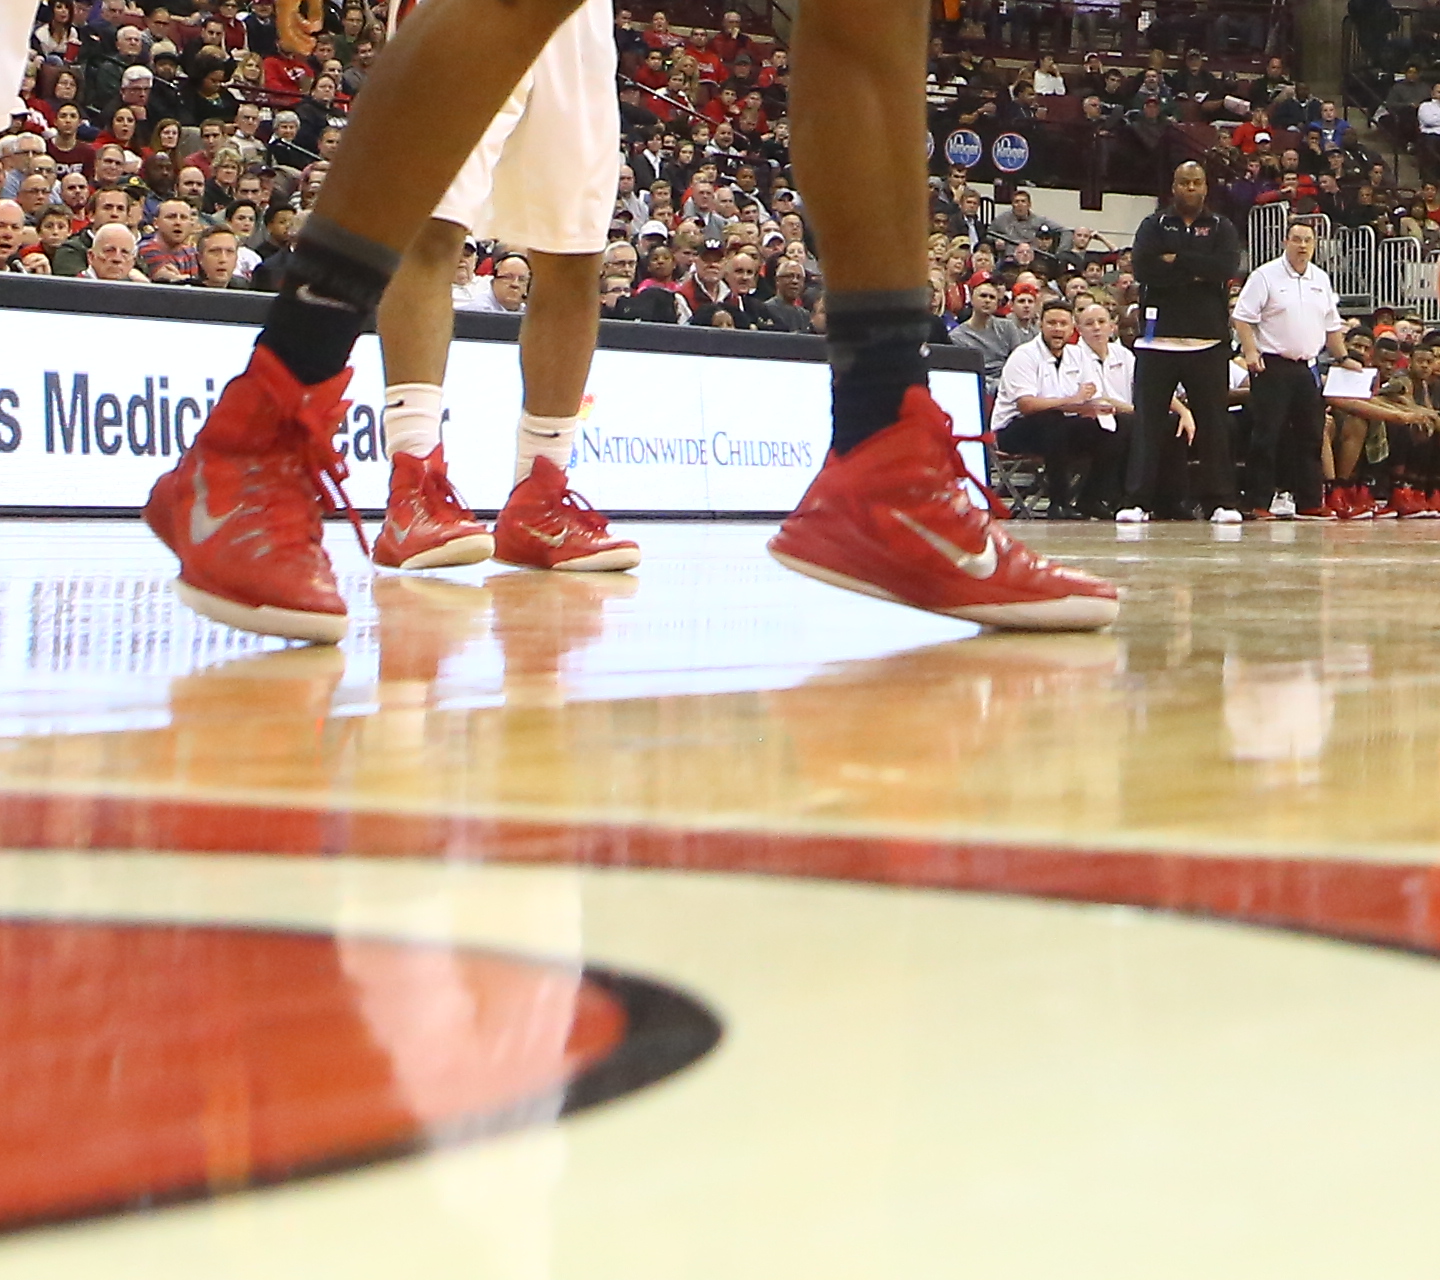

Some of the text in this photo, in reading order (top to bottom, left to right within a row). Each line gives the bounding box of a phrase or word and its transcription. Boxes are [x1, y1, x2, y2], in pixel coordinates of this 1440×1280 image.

[949, 134, 979, 163] Kroger
[997, 138, 1026, 166] Kroger
[56, 163, 83, 174] OVE
[43, 370, 222, 456] Medici
[582, 427, 814, 468] NATIONWIDE CHILDREN'S
